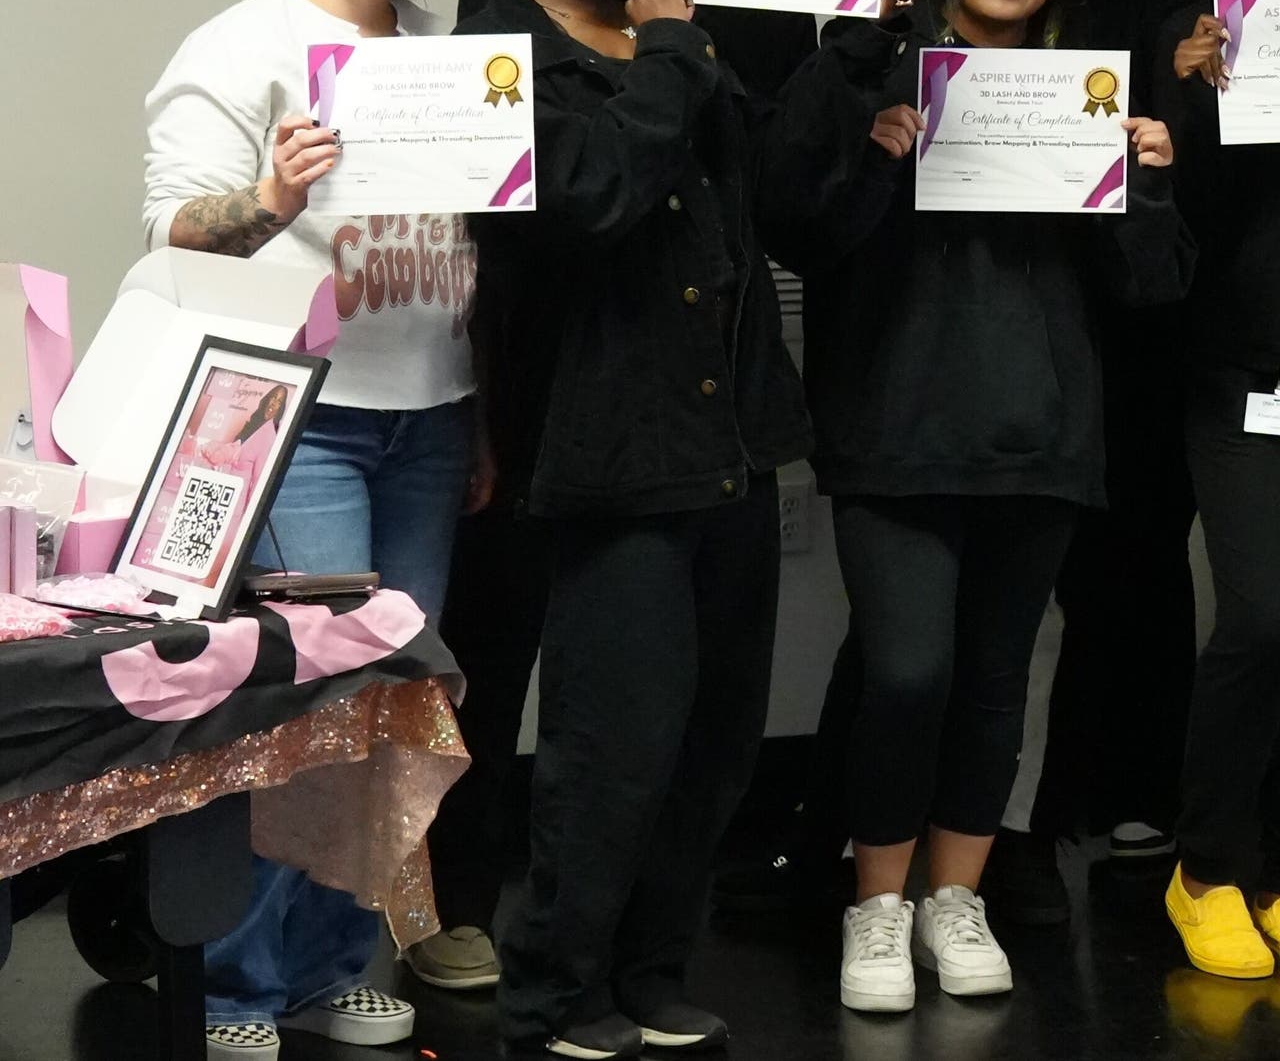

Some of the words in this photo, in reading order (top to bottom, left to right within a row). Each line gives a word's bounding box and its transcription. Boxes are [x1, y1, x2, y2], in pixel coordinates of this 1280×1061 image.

[969, 73, 1011, 83] ASPIRE
[1014, 73, 1045, 84] WITH
[1047, 74, 1076, 84] AMY
[1032, 91, 1057, 99] BROW
[962, 110, 1011, 129] Certificate
[1014, 113, 1026, 130] of
[1028, 111, 1083, 129] Completion
